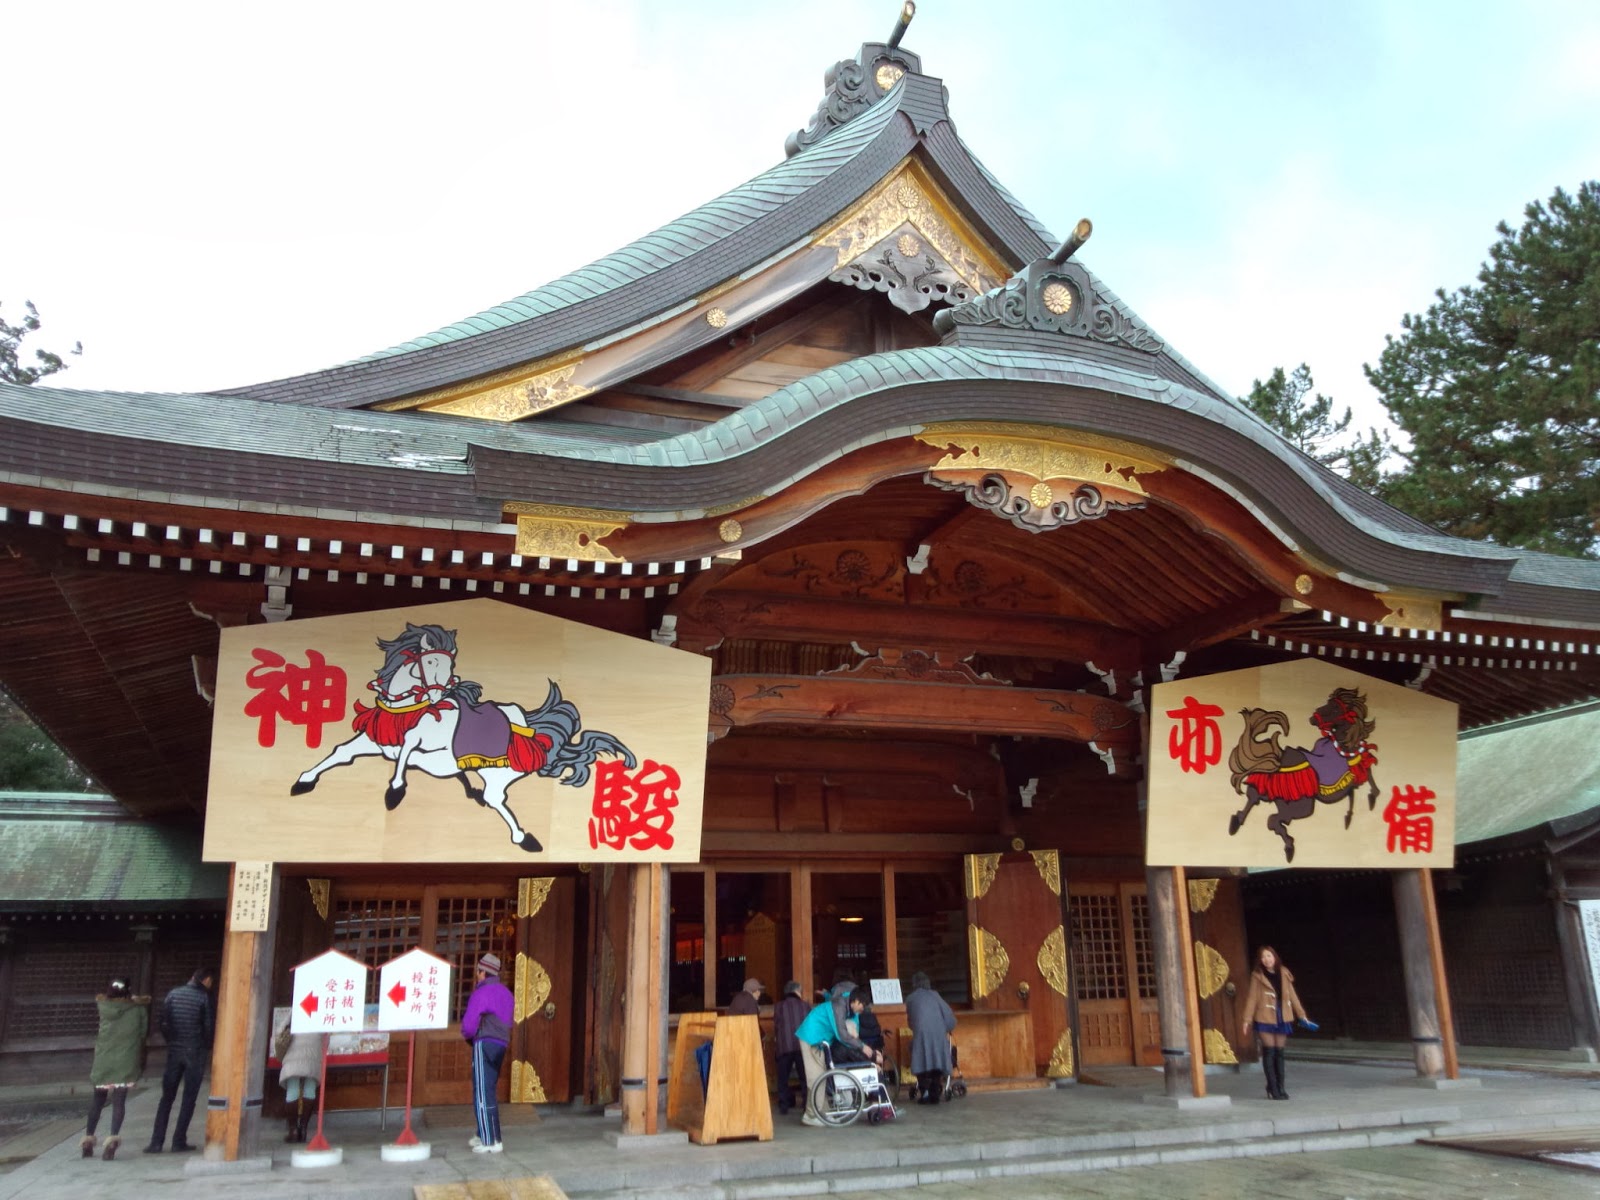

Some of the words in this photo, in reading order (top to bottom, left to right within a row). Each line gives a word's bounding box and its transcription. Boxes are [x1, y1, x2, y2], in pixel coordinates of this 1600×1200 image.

[244, 648, 348, 749] 神
[588, 758, 682, 851] 駿
[1383, 784, 1436, 854] 備
[323, 978, 338, 1026] 受付所
[341, 979, 354, 1024] お祓い
[410, 971, 423, 1014] 授与所
